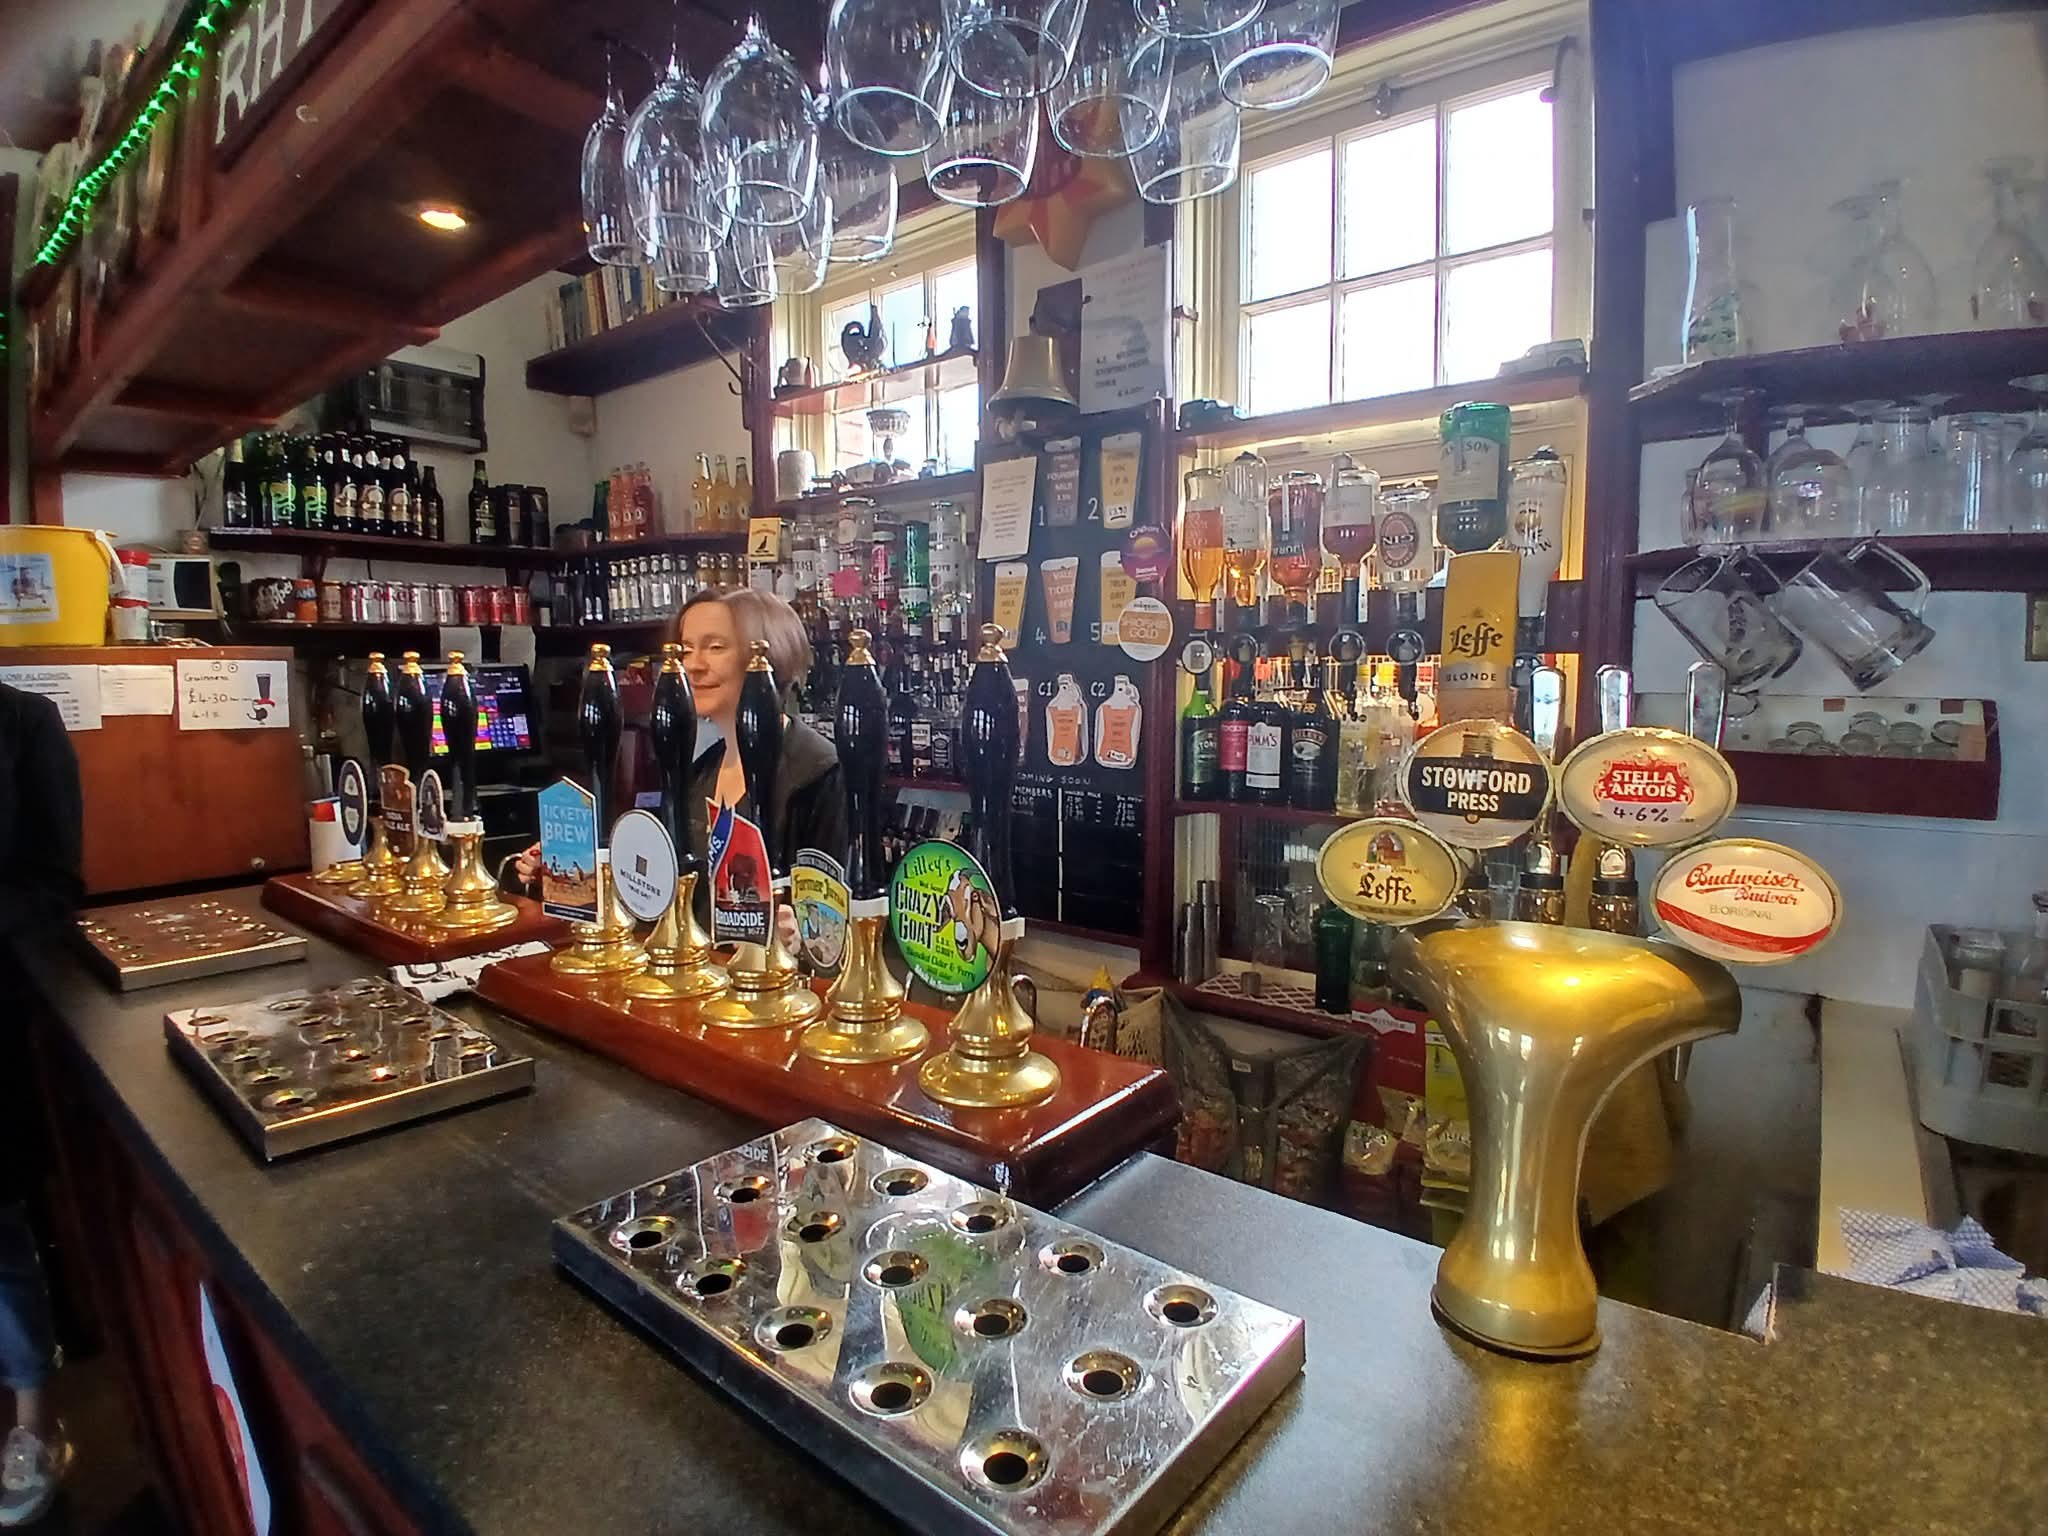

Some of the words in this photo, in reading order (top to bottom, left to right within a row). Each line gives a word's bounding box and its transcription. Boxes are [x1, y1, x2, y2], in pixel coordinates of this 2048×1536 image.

[1087, 497, 1099, 520] 2
[1035, 627, 1046, 645] 4
[1090, 622, 1101, 641] 5
[1449, 622, 1504, 658] Leffe
[1090, 682, 1106, 697] C2
[1421, 765, 1532, 795] STOWFORD
[1611, 769, 1678, 786] STELLA
[1609, 782, 1677, 798] ARTOIS
[1446, 791, 1500, 812] PRESS
[1613, 806, 1670, 823] 4.6%
[544, 821, 590, 845] BREW
[903, 856, 952, 878] Lilley's
[1685, 862, 1804, 889] Budweiser
[1356, 872, 1417, 906] Leffe
[895, 881, 945, 927] CRAZY
[899, 912, 933, 949] GOAT
